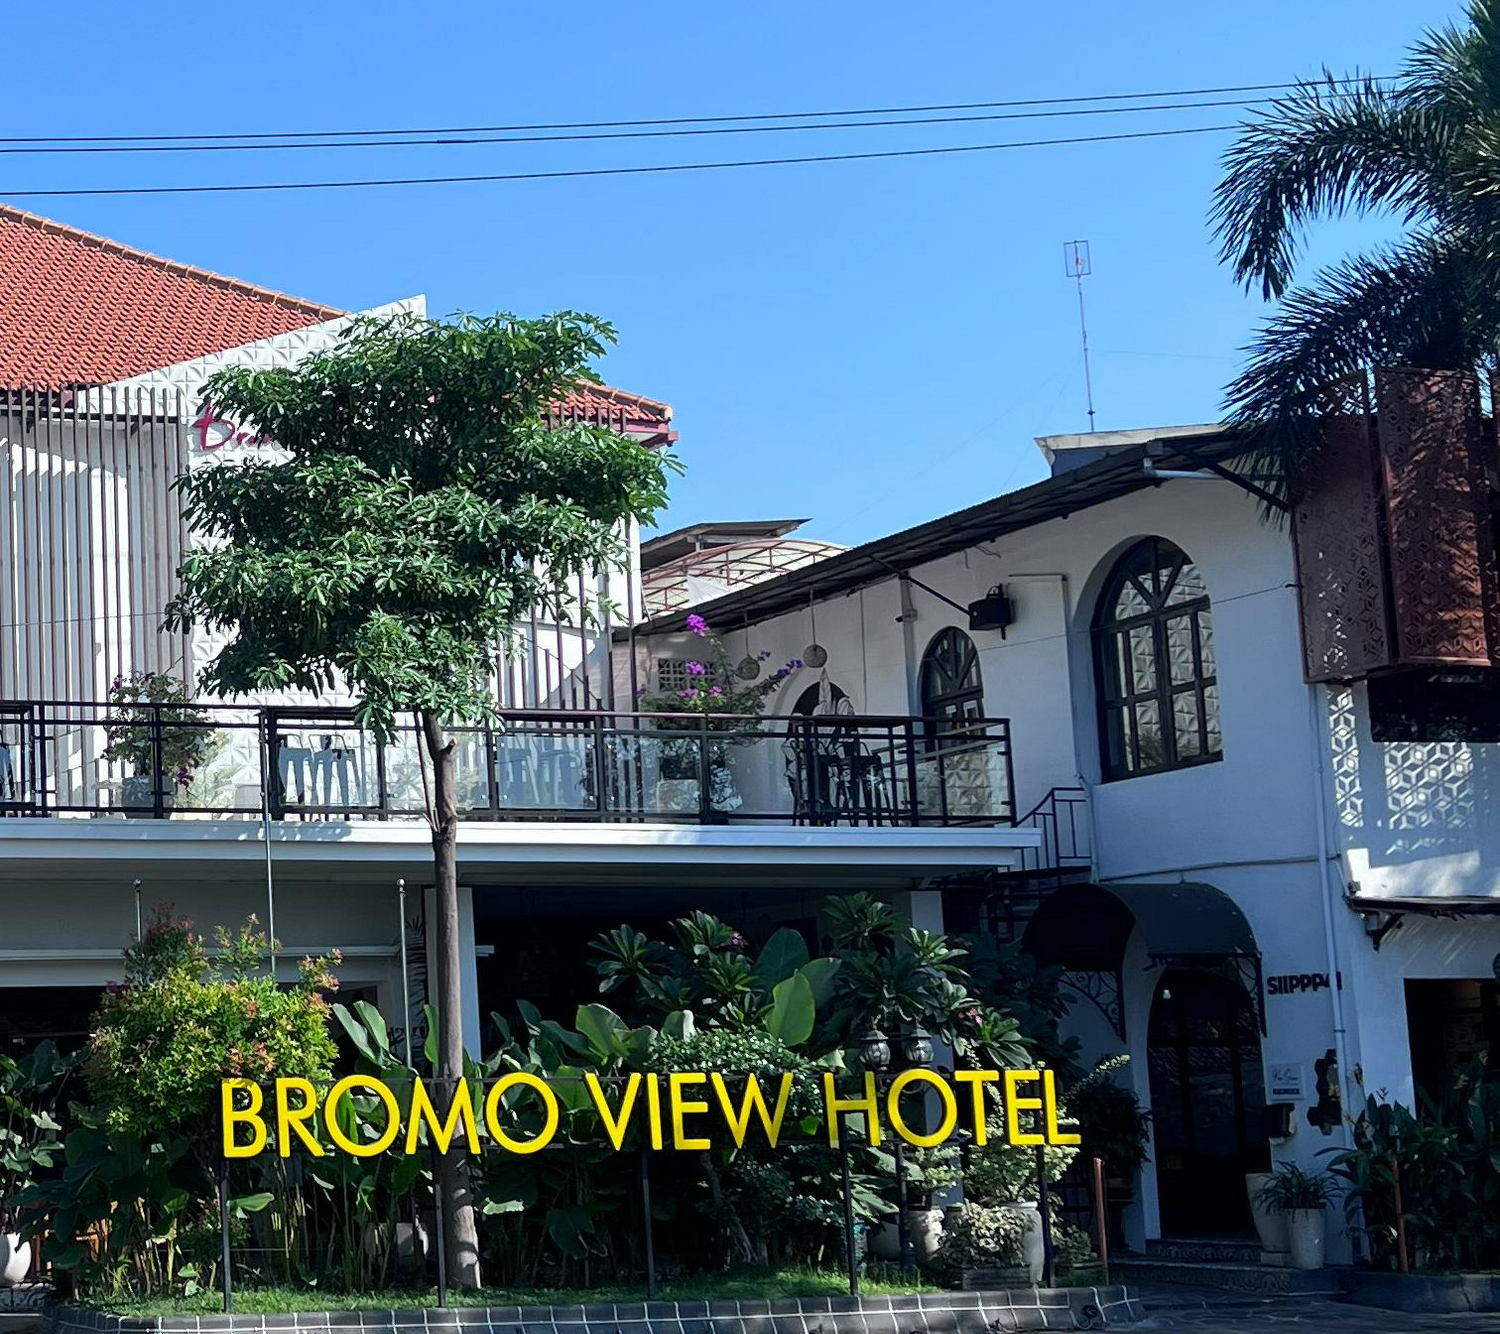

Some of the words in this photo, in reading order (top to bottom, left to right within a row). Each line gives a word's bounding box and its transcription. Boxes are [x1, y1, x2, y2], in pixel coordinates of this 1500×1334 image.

[221, 1072, 559, 1158] BROMO
[584, 1071, 794, 1151] VIEW
[823, 1068, 1082, 1148] HOTEL
